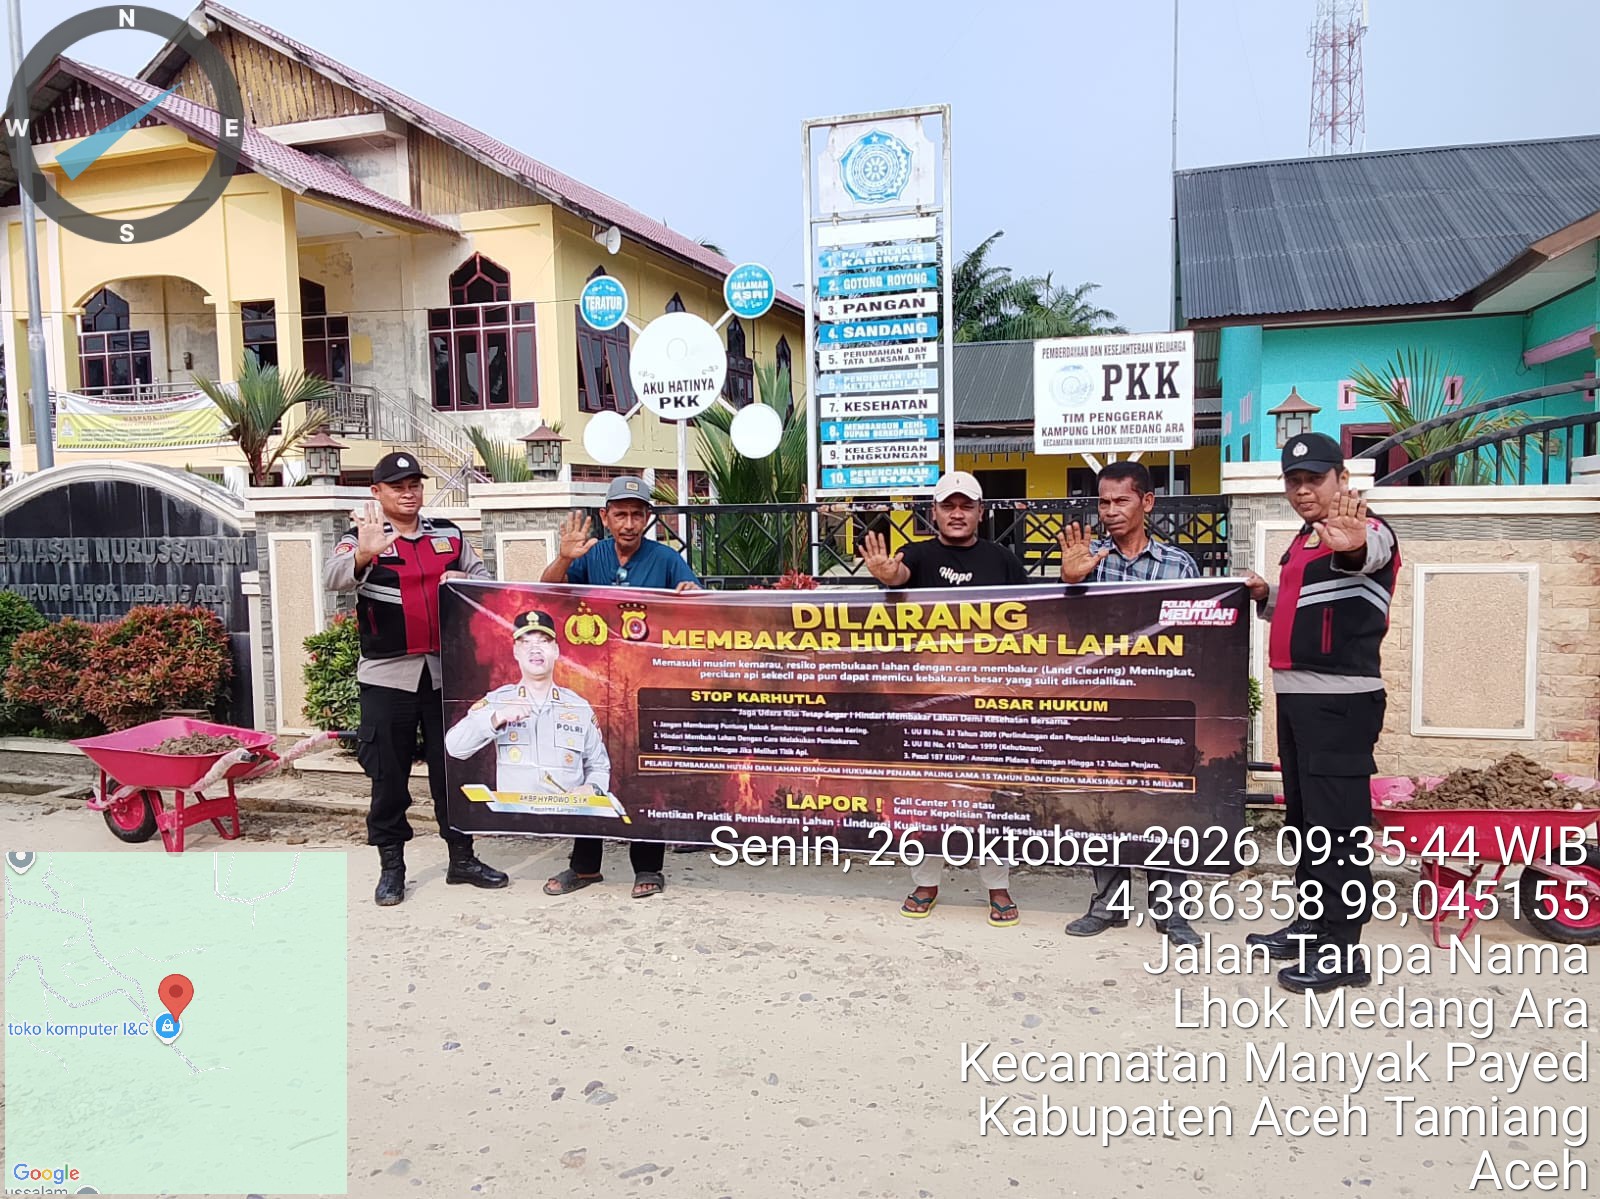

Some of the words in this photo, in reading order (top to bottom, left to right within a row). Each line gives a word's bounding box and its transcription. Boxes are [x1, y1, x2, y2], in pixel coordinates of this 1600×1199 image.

[731, 280, 768, 291] HALAMAN
[828, 280, 839, 291] 2.
[843, 276, 883, 290] GOTONG
[887, 272, 928, 287] ROYONG
[584, 295, 623, 312] TERATUR
[731, 290, 768, 301] ASRI
[828, 305, 838, 316] 3.
[843, 297, 926, 315] PANGAN
[828, 328, 839, 340] 4.
[843, 321, 928, 339] SANDANG
[828, 354, 838, 365] 5.
[843, 348, 902, 358] PERUMAHAN
[908, 346, 927, 354] DAN
[1090, 345, 1103, 357] DAN
[1104, 343, 1154, 356] KESEJAHTERAAN
[1155, 340, 1186, 353] KELUARGA
[843, 358, 864, 366] TATA
[869, 355, 910, 364] LAKSANA
[915, 353, 927, 361] RT
[642, 381, 664, 395] AKU
[668, 378, 714, 393] HATINYA
[1101, 360, 1180, 402] PKK
[659, 395, 700, 409] PKK
[829, 402, 839, 413] 7.
[844, 399, 928, 412] KESEHATAN
[1062, 413, 1085, 424] TIM
[1089, 410, 1164, 423] PENGGERAK
[829, 424, 839, 438] 8.
[1041, 426, 1088, 438] KAMPUNG
[1092, 425, 1117, 436] LHOK
[1120, 423, 1162, 435] MEDANG
[1165, 422, 1185, 433] ARA
[1043, 438, 1073, 447] KECAMATAN
[1096, 437, 1113, 446] PAYED
[1144, 435, 1158, 444] ACEH
[830, 449, 840, 460] 9.
[845, 445, 928, 454] KELESTARIAN
[845, 452, 928, 461] LINGKUNGAN
[830, 471, 847, 485] 10.
[850, 467, 929, 477] PERENCANAAN
[850, 475, 925, 486] SEHAT
[95, 537, 249, 564] NURUSSALAM
[939, 566, 973, 585] Hippo
[75, 583, 120, 602] LHOK
[122, 583, 190, 602] MEDANG
[194, 584, 231, 603] ARA
[791, 601, 1029, 630] DILARANG
[661, 630, 841, 650] MEMBAKAR
[850, 631, 964, 652] HUTAN
[973, 633, 1048, 654] DAN
[1057, 634, 1185, 655] LAHAN
[652, 658, 701, 667] Memasuki
[703, 659, 737, 667] musim
[738, 659, 784, 669] kemarau,
[786, 660, 817, 669] resiko
[819, 661, 879, 673] pembukaan
[881, 662, 911, 670] lahan
[912, 663, 952, 674] dengan
[980, 664, 1039, 673] membakar
[1041, 665, 1073, 675] (Land
[1075, 665, 1126, 677] Clearing)
[1129, 666, 1196, 678] Meningkat,
[699, 670, 741, 680] percikan
[743, 671, 759, 680] api
[761, 671, 794, 679] sekecil
[817, 674, 837, 682] pun
[839, 673, 869, 683] dapat
[871, 673, 914, 682] memicu
[916, 673, 971, 683] kebakaran
[973, 674, 1002, 683] besar
[1004, 677, 1032, 686] yang
[1035, 675, 1059, 684] sulit
[1061, 675, 1136, 686] dikendalikan.
[691, 690, 733, 703] STOP
[737, 692, 827, 706] KARHUTLA
[974, 697, 1034, 711] DASAR
[1039, 699, 1109, 712] HUKUM
[556, 722, 583, 734] POLRI
[644, 760, 673, 768] PELAKU
[674, 761, 725, 770] PEMBAKARAN
[726, 763, 753, 771] HUTAN
[754, 764, 772, 772] DAN
[773, 765, 801, 773] LAHAN
[802, 766, 841, 775] DIANCAM
[842, 768, 884, 776] HUKUMAN
[886, 769, 921, 778] PENJARA
[923, 770, 953, 778] PALING
[981, 772, 992, 780] 15
[993, 773, 1023, 781] TAHUN
[1024, 774, 1044, 782] DAN
[1045, 775, 1076, 783] DENDA
[1077, 776, 1123, 785] MAKSIMAL
[1139, 779, 1151, 787] 15
[1152, 779, 1184, 788] MILIAR
[785, 794, 869, 813] LAPOR
[875, 797, 884, 813] !
[893, 797, 913, 806] Call
[914, 798, 948, 808] Center
[951, 799, 970, 809] 110
[972, 802, 996, 811] atau
[647, 808, 694, 818] Hentikan
[696, 811, 733, 820] Praktik
[735, 813, 800, 823] Pembakaran
[802, 815, 834, 824] Lahan
[893, 807, 928, 815] Kantor
[929, 808, 984, 820] Kepolisian
[985, 811, 1031, 820] Terdekat
